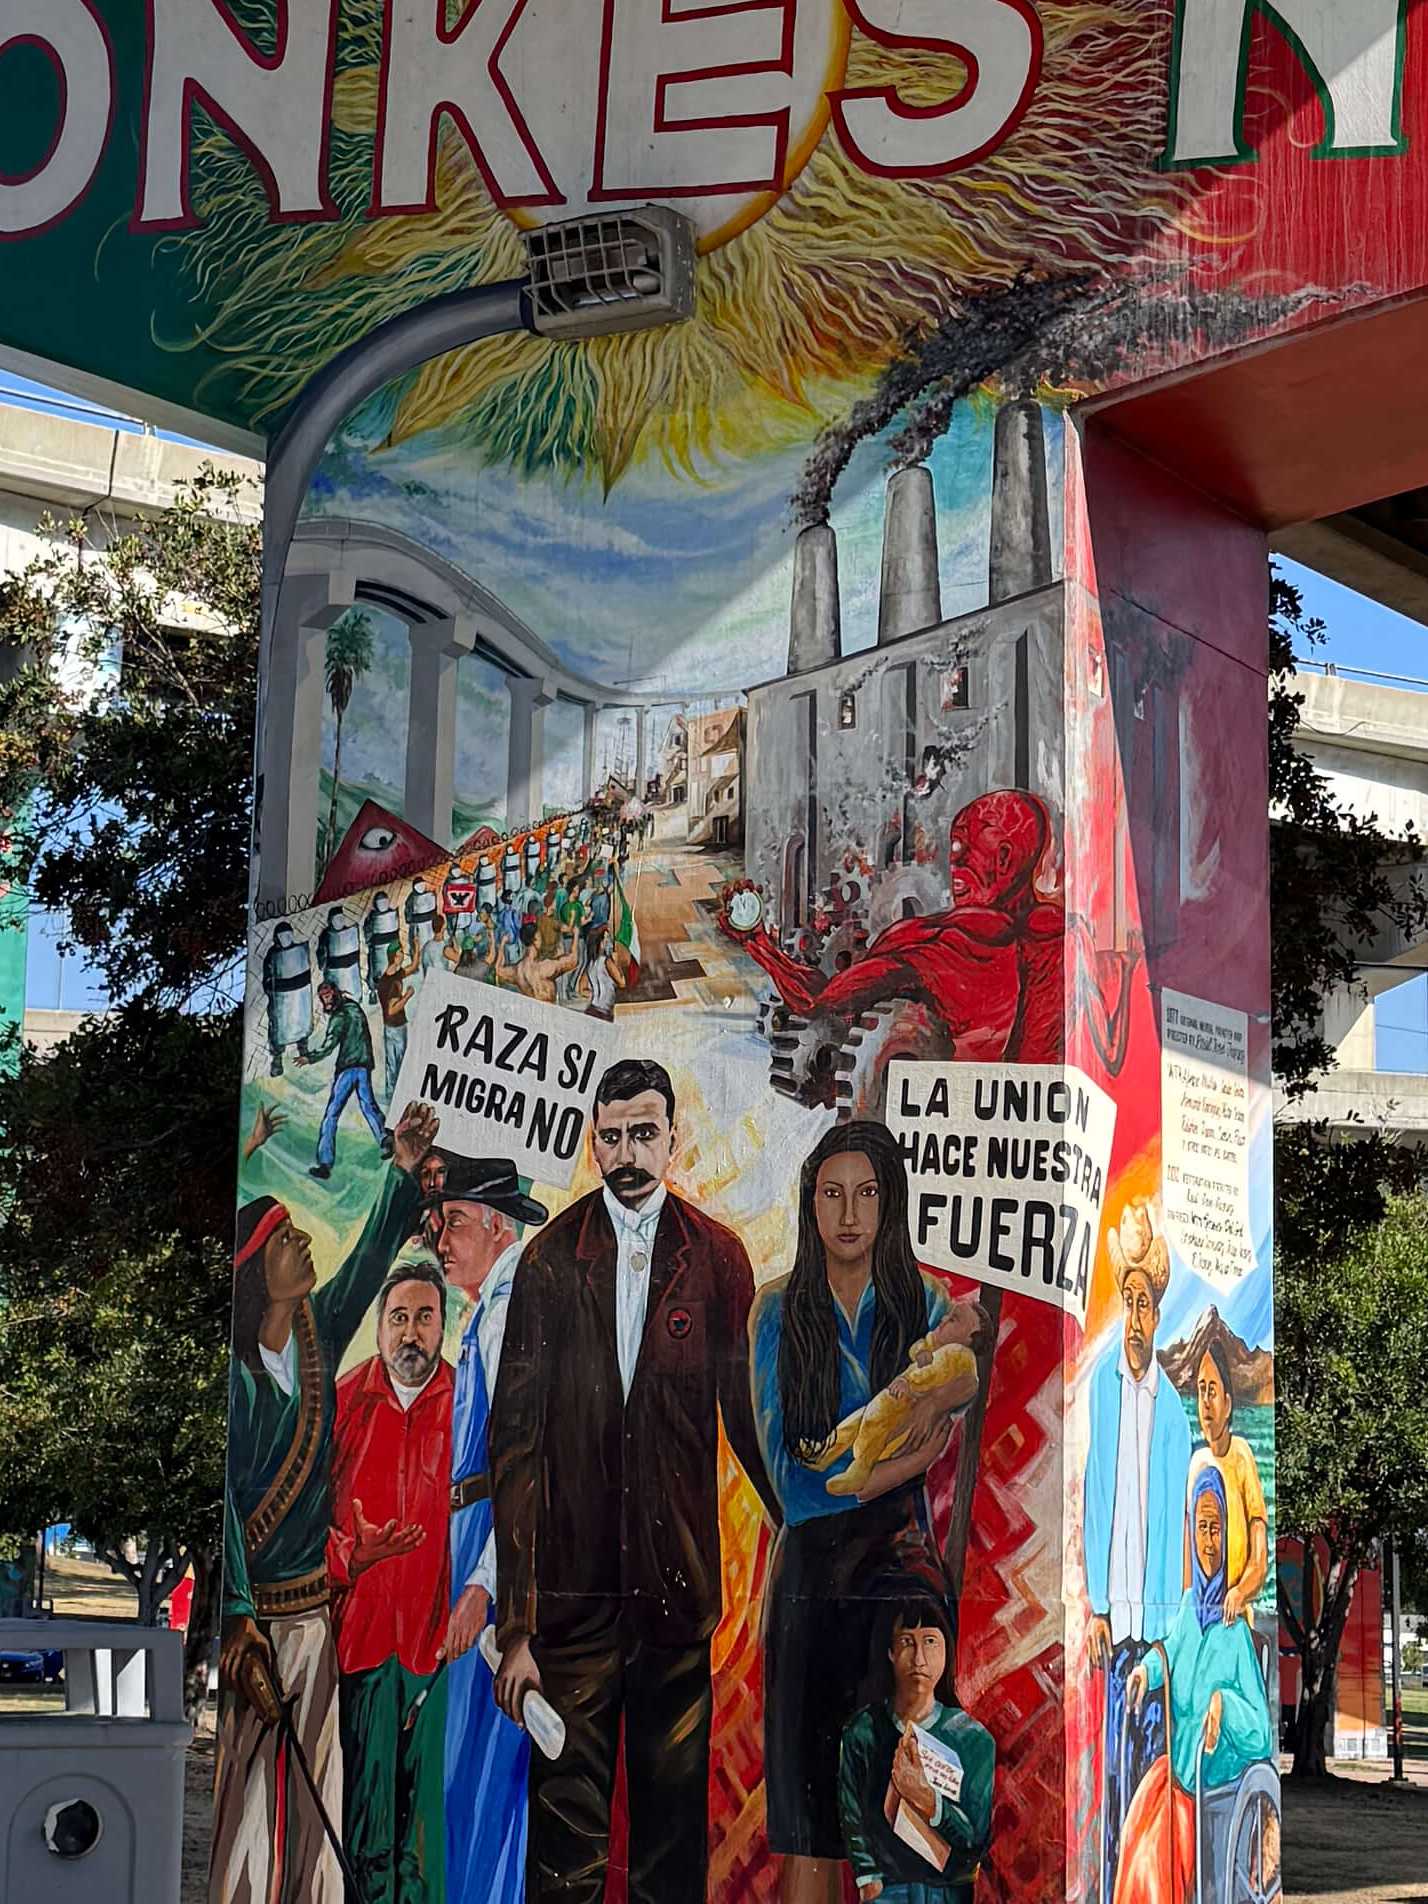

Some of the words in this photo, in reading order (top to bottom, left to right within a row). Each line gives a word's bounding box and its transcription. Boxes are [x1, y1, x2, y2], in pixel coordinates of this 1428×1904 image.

[435, 1004, 549, 1081] RAZA
[558, 1043, 597, 1094] SI
[420, 1063, 526, 1129] MIGRA
[526, 1097, 584, 1160] NO
[900, 1078, 949, 1118] LA
[975, 1079, 1089, 1133] UNION
[899, 1131, 978, 1178] HACE
[987, 1137, 1102, 1210] NUESTRA
[917, 1193, 1091, 1311] FUERZA
